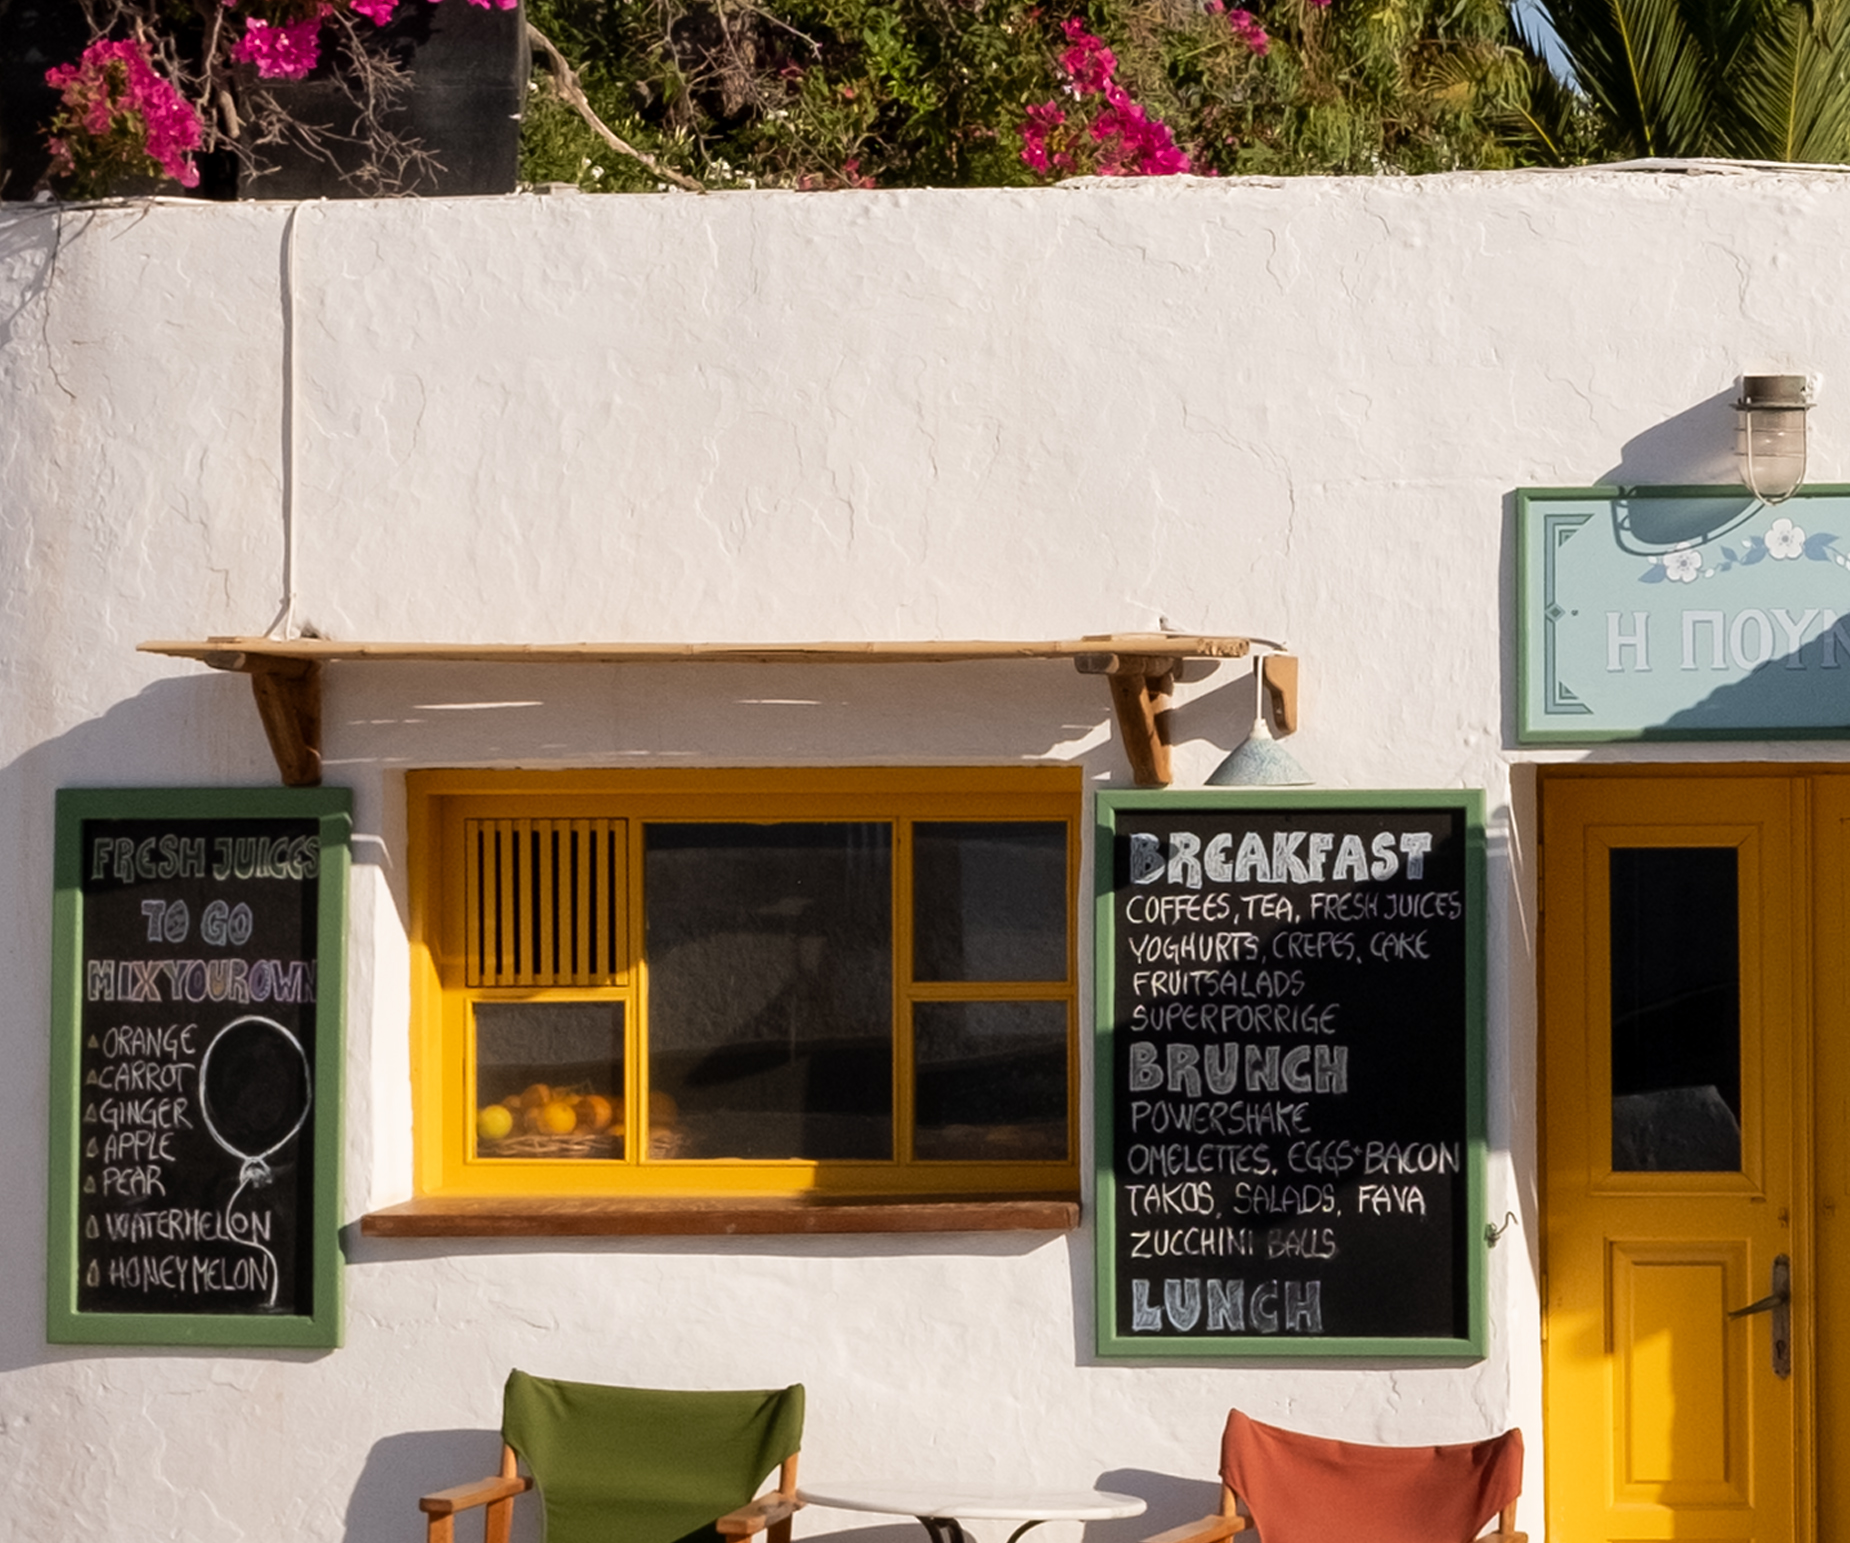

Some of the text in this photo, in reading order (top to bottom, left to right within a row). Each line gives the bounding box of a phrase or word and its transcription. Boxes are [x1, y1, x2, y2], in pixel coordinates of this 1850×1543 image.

[1605, 611, 1652, 672] Η
[90, 834, 321, 883] FRESH JUICES
[1129, 831, 1433, 888] BREAKFAST
[140, 899, 253, 946] TO GO
[1126, 892, 1239, 926] COFFEES,
[1311, 892, 1378, 921] FRESH
[1384, 891, 1462, 920] JUICES
[1129, 930, 1432, 964] YOGHURTS, CREPES, CAKE
[103, 1023, 198, 1058] ORANGE
[99, 1060, 197, 1093] CARROT
[1129, 1042, 1349, 1098] BRUNCH
[100, 1096, 194, 1130] GINGER
[1131, 1102, 1311, 1136] POWERSHAKE
[104, 1131, 175, 1162] APPLE
[103, 1167, 166, 1198] PEAR
[1126, 1183, 1426, 1219] TAKOS, SALADS, FAVA
[106, 1208, 270, 1242] WATERMELON
[1131, 1227, 1337, 1259] ZUCCHINI BALLS
[1131, 1279, 1325, 1332] LUNCH
